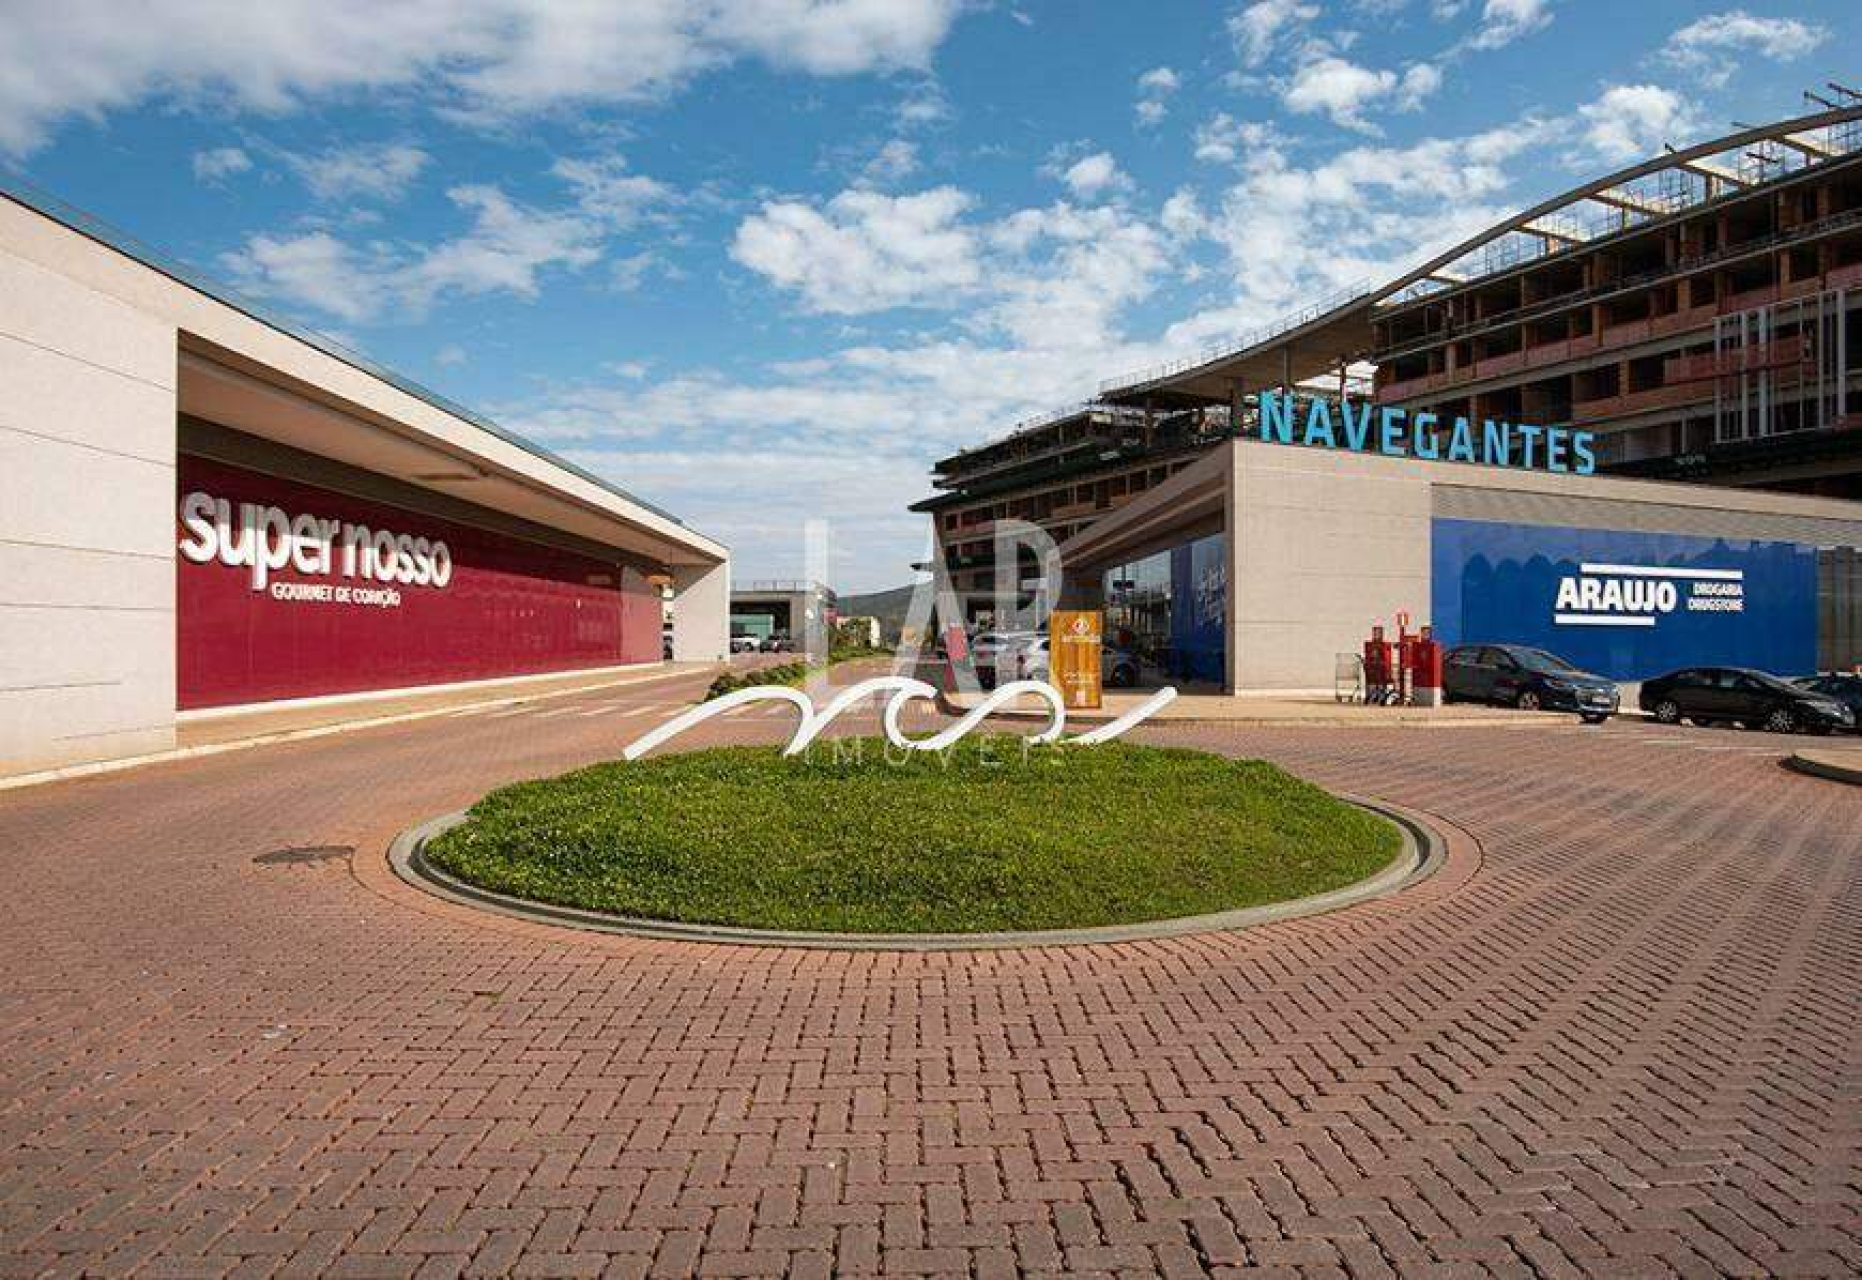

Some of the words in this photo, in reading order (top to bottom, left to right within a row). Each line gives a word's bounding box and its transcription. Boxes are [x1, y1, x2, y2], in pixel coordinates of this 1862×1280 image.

[1258, 389, 1597, 475] NAVEGANTES
[179, 491, 340, 590] super
[342, 522, 452, 588] nosso
[1555, 577, 1677, 612] ARAUJO
